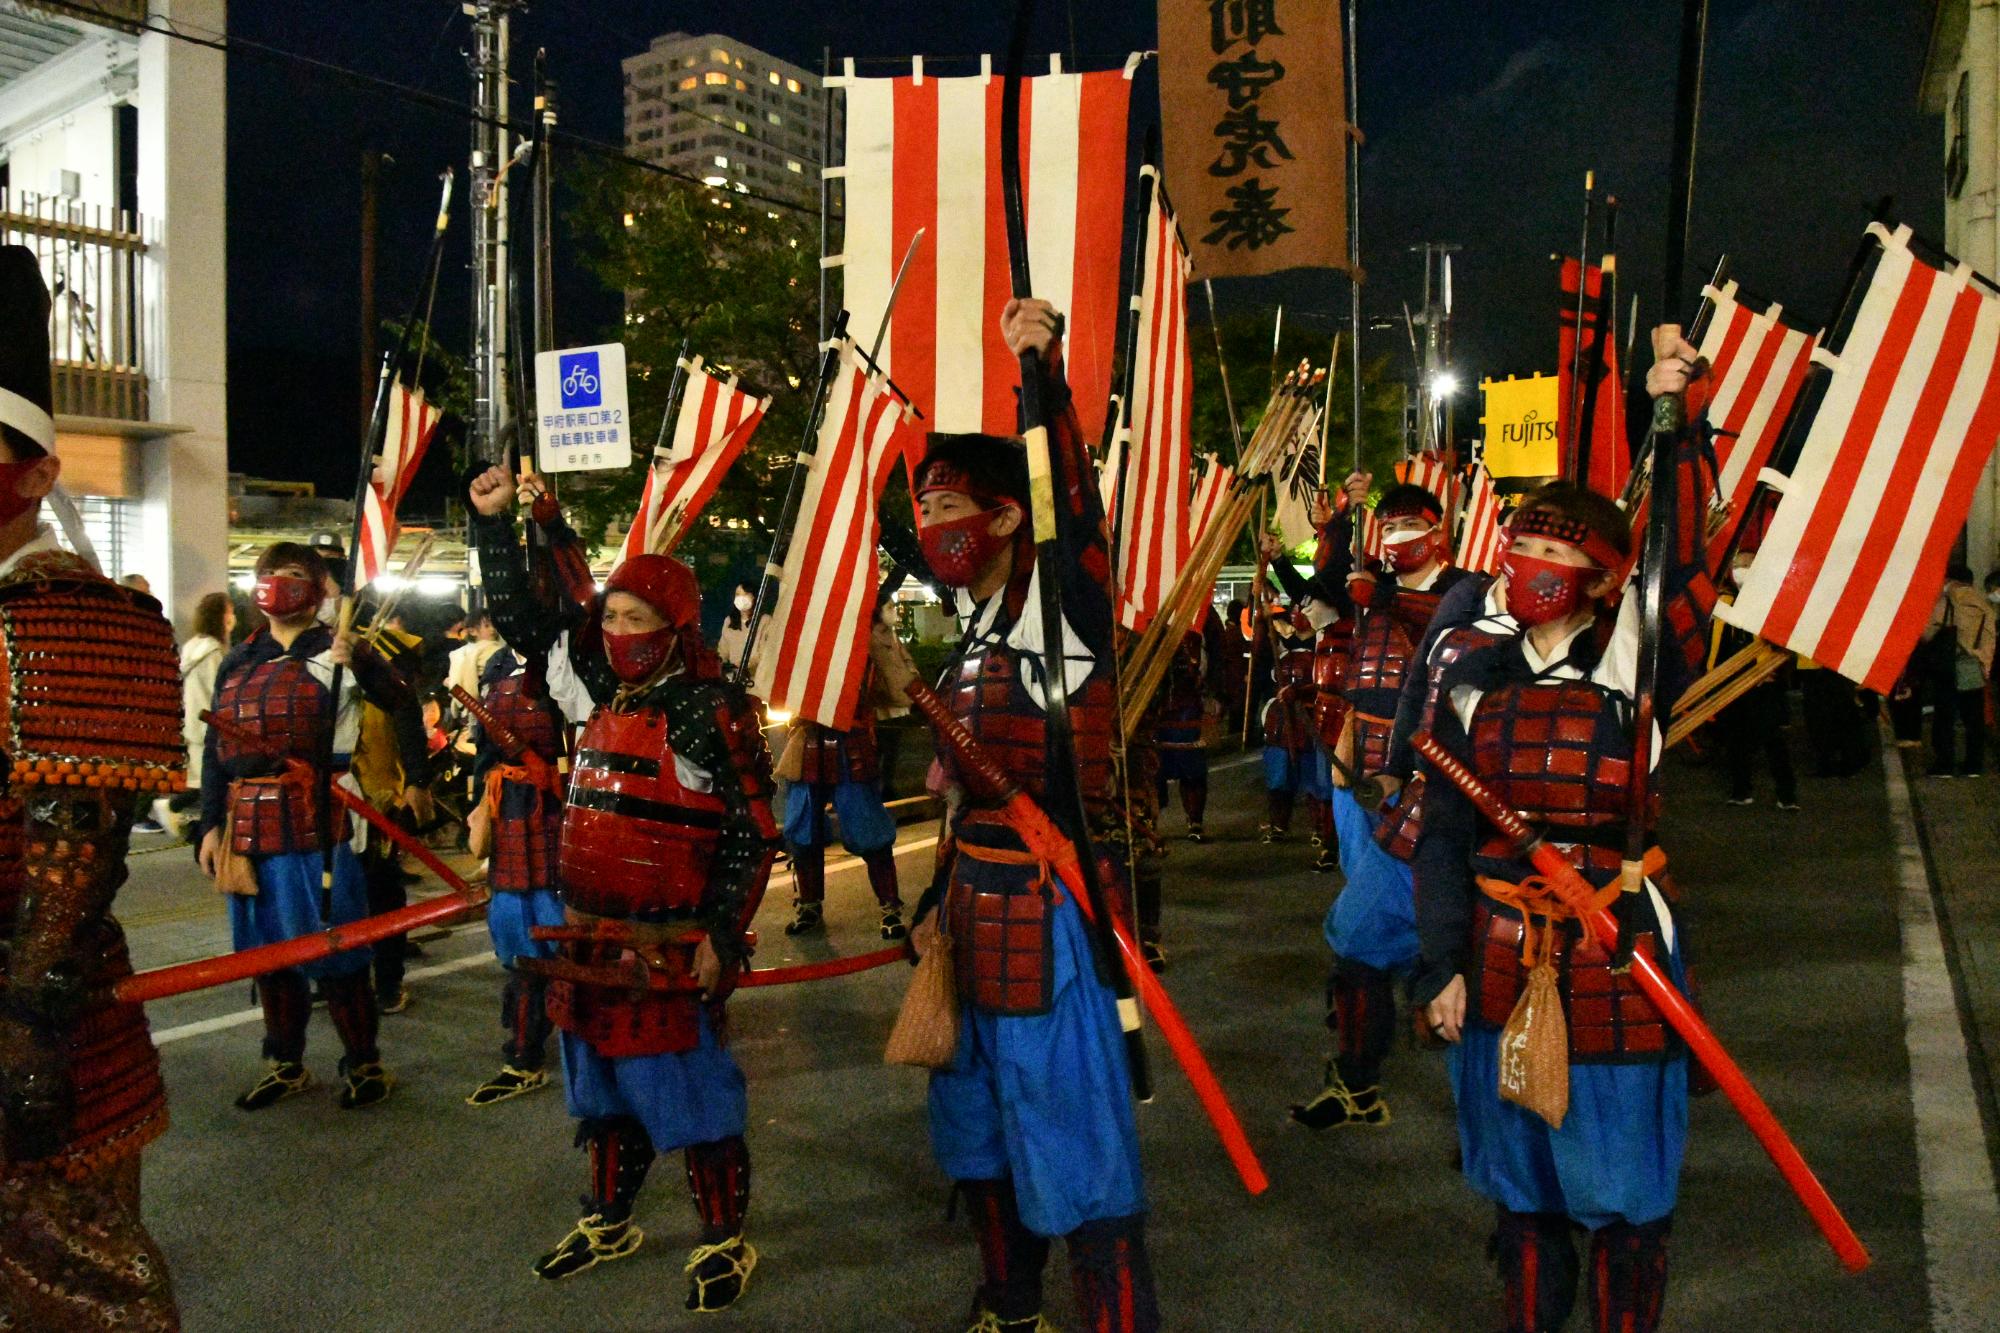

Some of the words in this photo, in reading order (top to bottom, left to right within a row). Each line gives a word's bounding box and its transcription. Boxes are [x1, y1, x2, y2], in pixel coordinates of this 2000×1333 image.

[543, 409, 622, 430] 甲府駅南口第2
[550, 428, 619, 448] 自転車駐車場
[1501, 420, 1558, 448] FUJITS
